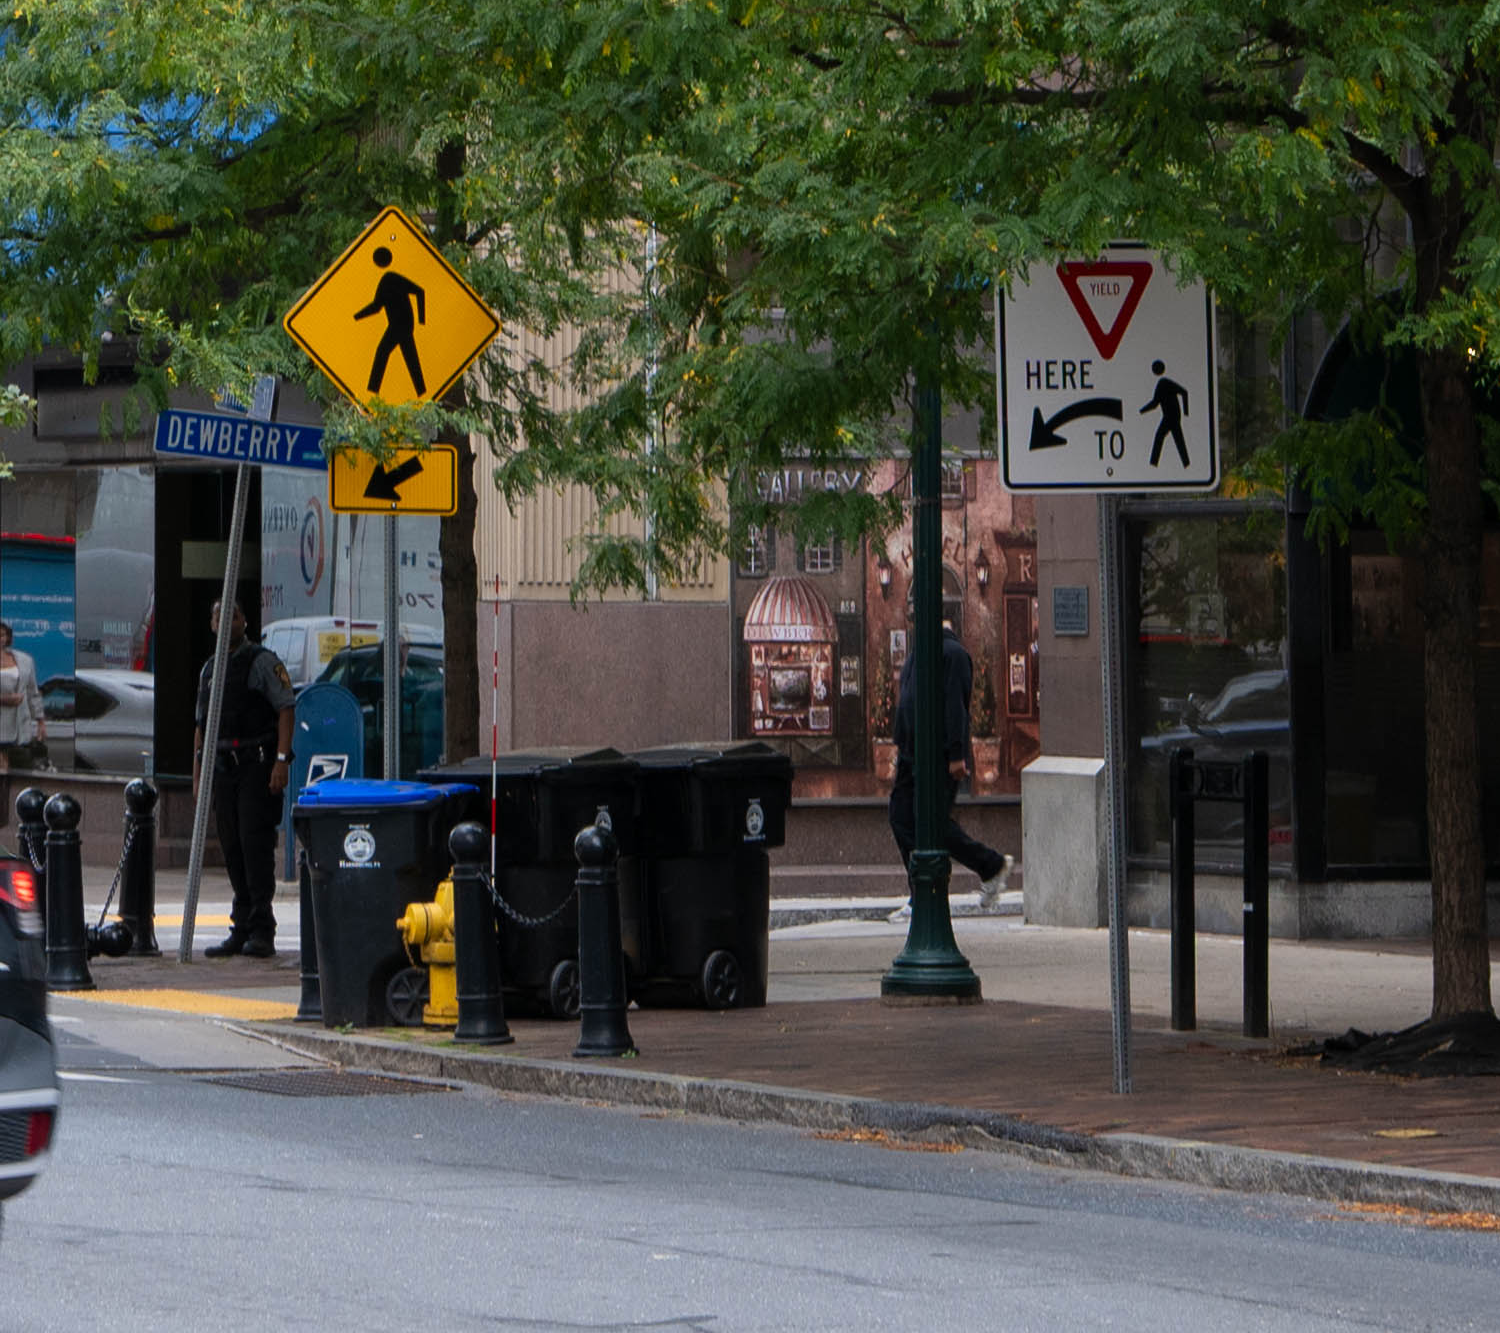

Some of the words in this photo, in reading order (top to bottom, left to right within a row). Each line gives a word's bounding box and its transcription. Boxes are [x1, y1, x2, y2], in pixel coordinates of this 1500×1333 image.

[1090, 282, 1120, 296] YIELD
[1025, 360, 1094, 391] HERE
[167, 415, 300, 462] DEWBERRY
[1095, 430, 1125, 461] TO
